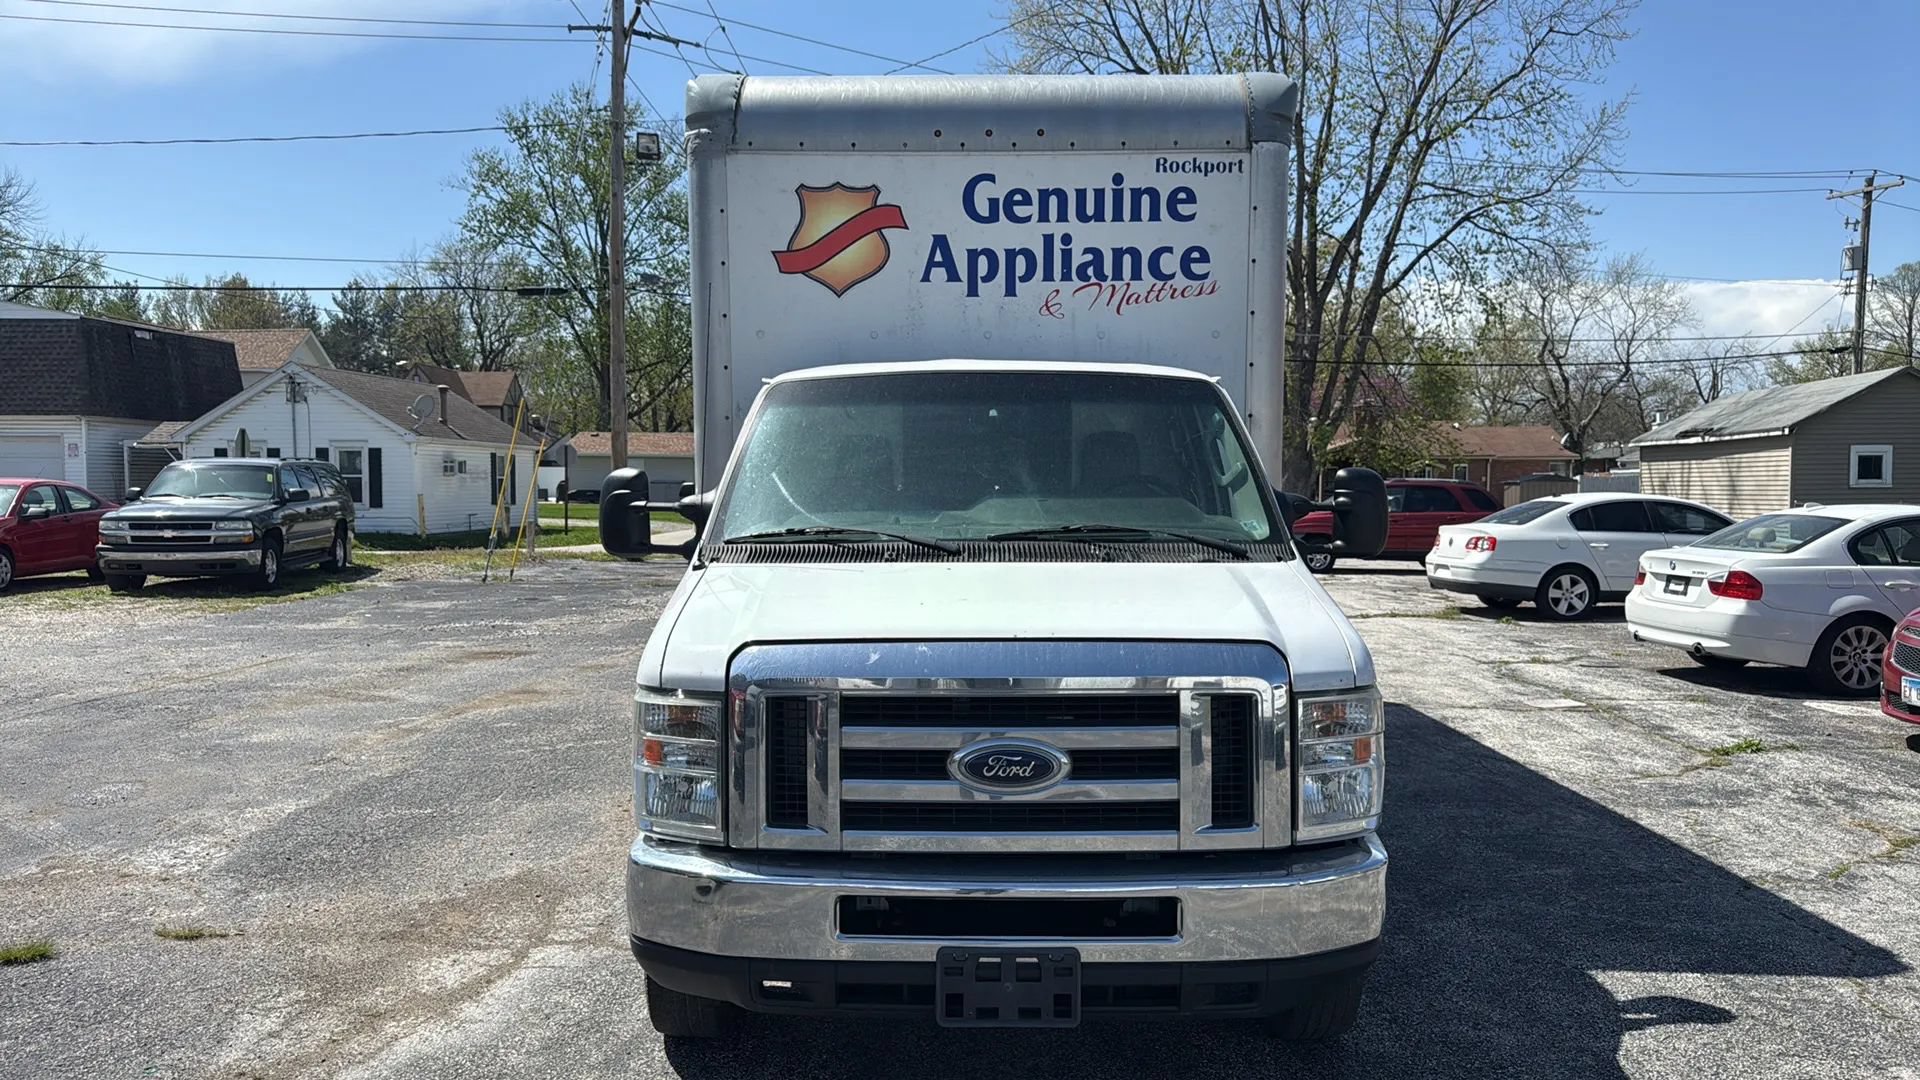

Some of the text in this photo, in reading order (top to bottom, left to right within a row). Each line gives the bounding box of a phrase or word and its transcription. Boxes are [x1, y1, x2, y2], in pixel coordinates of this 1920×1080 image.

[1155, 157, 1244, 176] Rockport
[962, 172, 1198, 225] Genuine
[920, 233, 1211, 297] Appliance
[1039, 280, 1221, 319] & Mattress
[983, 755, 1035, 777] Ford
